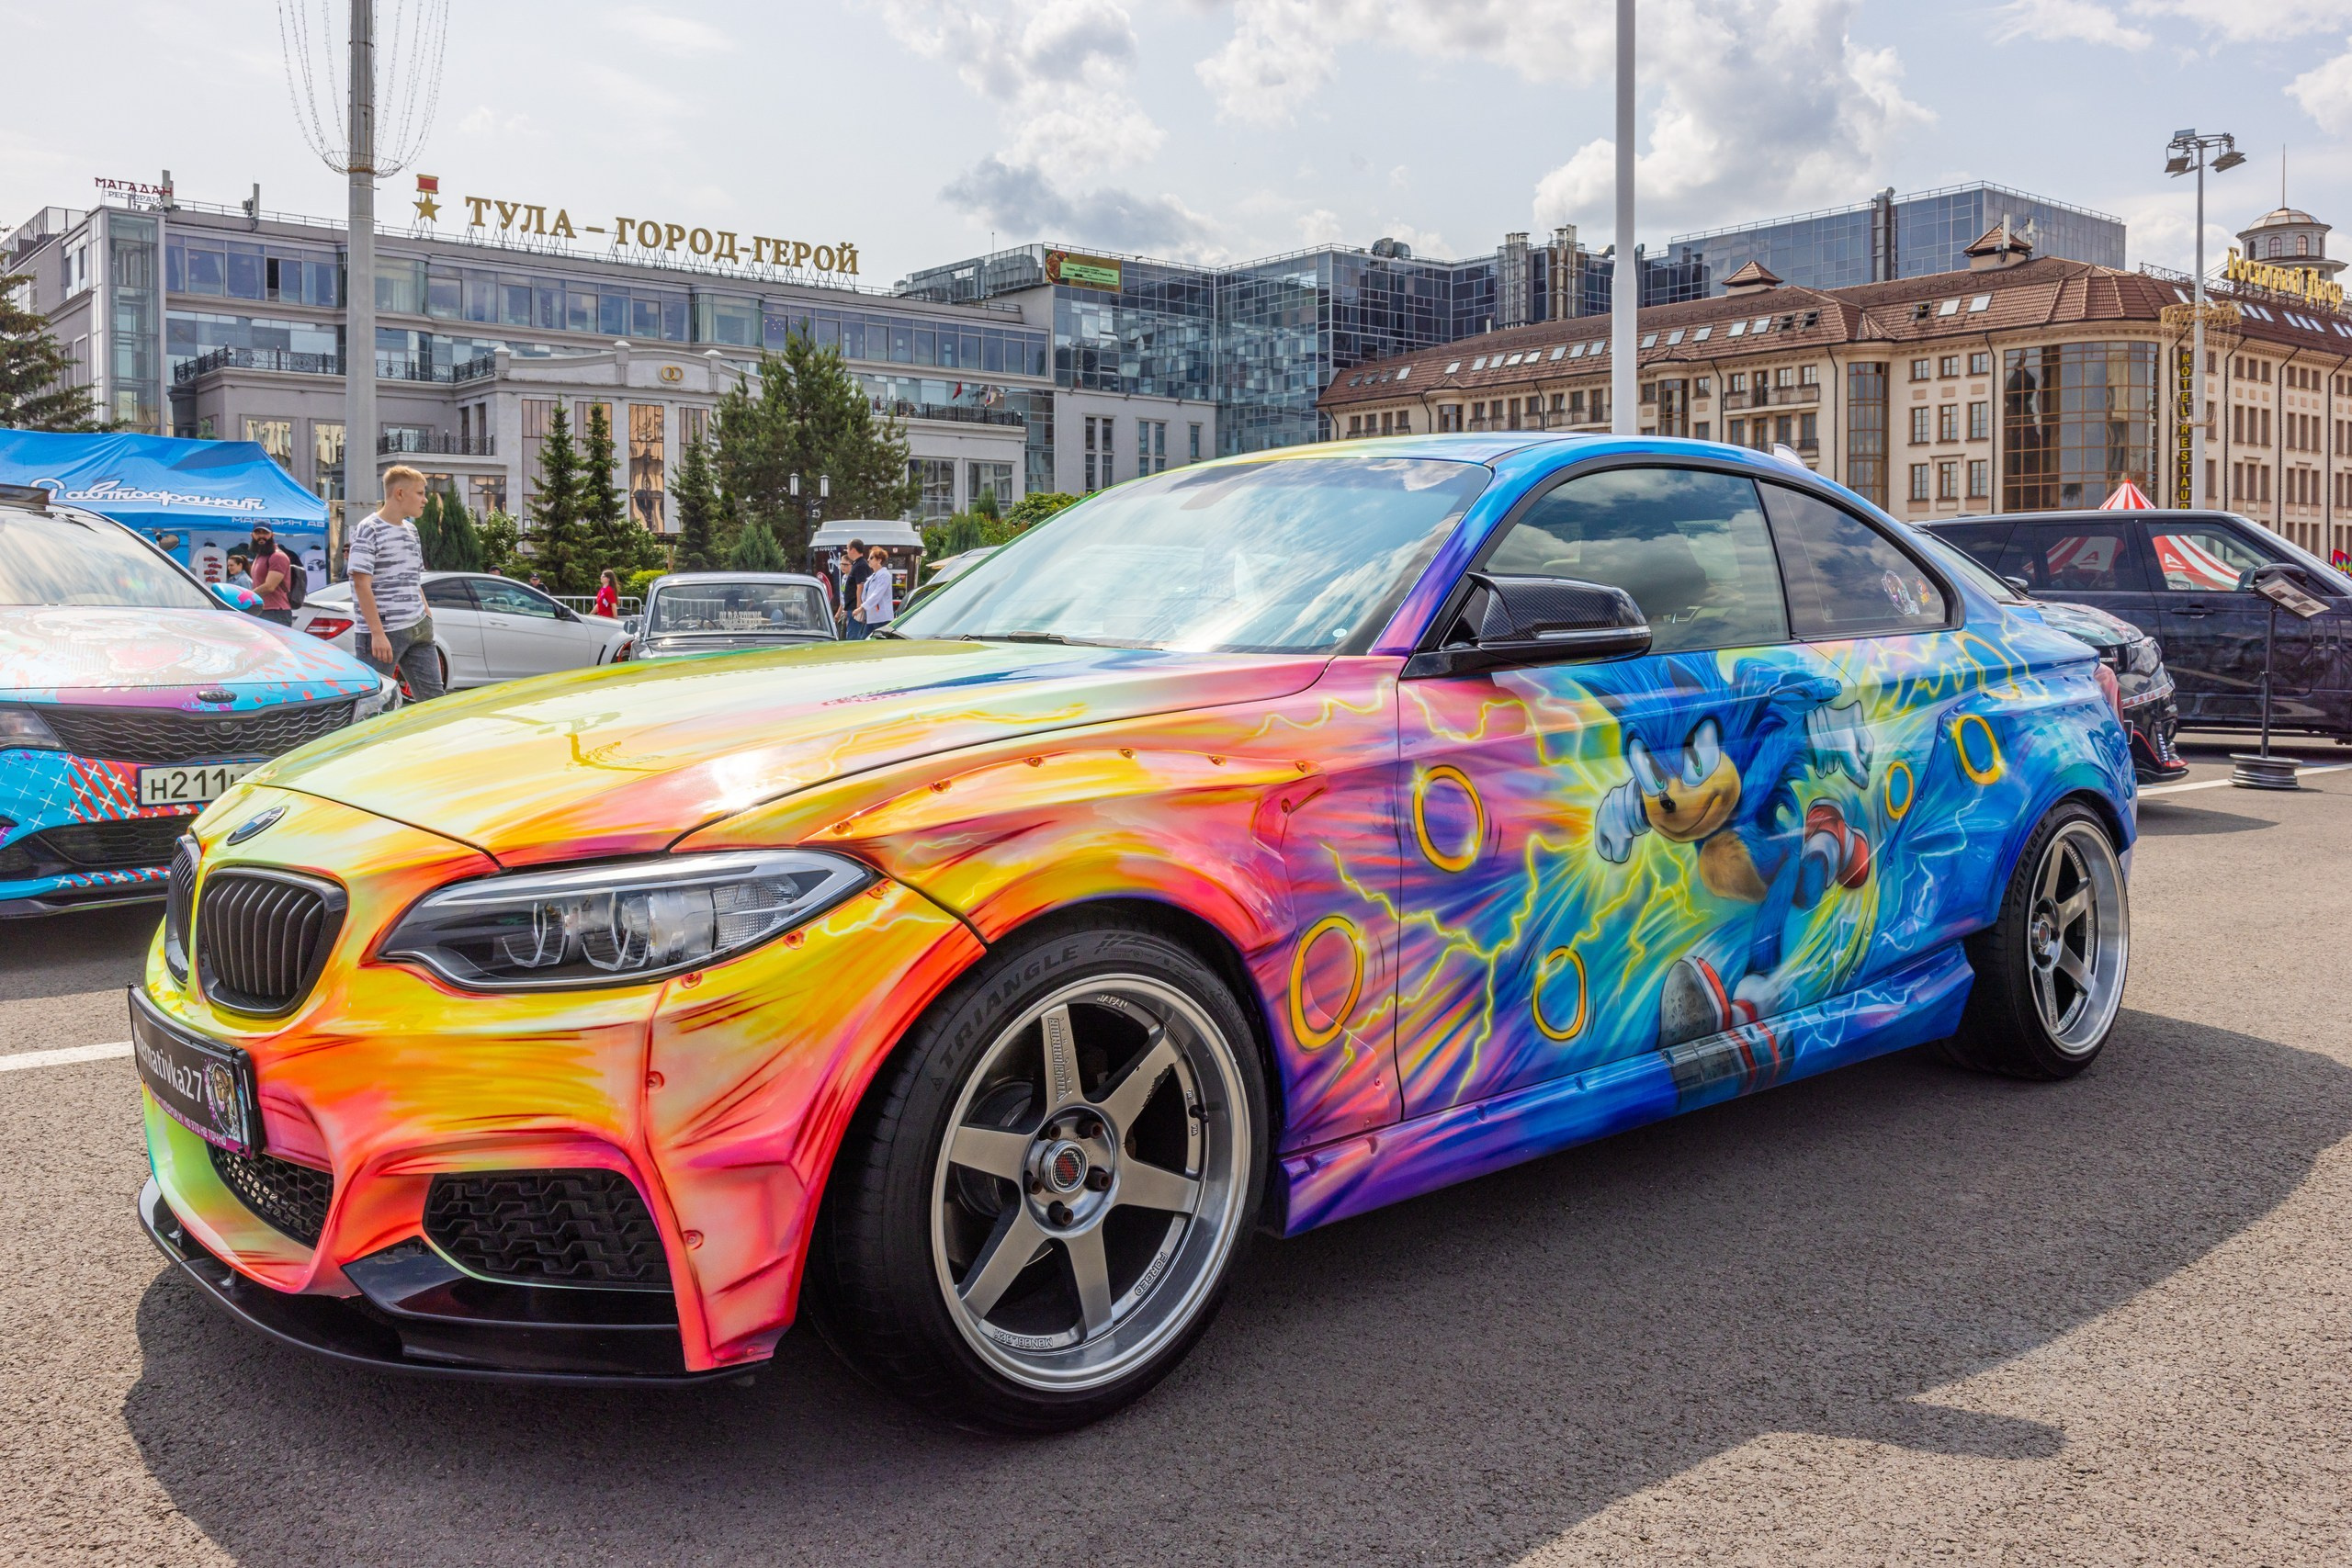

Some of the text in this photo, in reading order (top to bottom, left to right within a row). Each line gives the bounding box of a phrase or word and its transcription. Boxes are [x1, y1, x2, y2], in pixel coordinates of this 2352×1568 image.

[95, 177, 173, 197] МАГАДАН
[465, 196, 577, 239] ТУЛА
[616, 216, 860, 276] ГОРОД-ГЕРОЙ
[2227, 246, 2344, 312] Гостиный Двор
[2180, 354, 2190, 417] HOTEL
[2013, 818, 2049, 908] TRIANGLE
[939, 944, 1079, 1069] TRIANGLE
[1097, 995, 1128, 1010] JAPAN
[1135, 1251, 1168, 1296] FORGED
[993, 1328, 1054, 1348] MONOBLOCK
